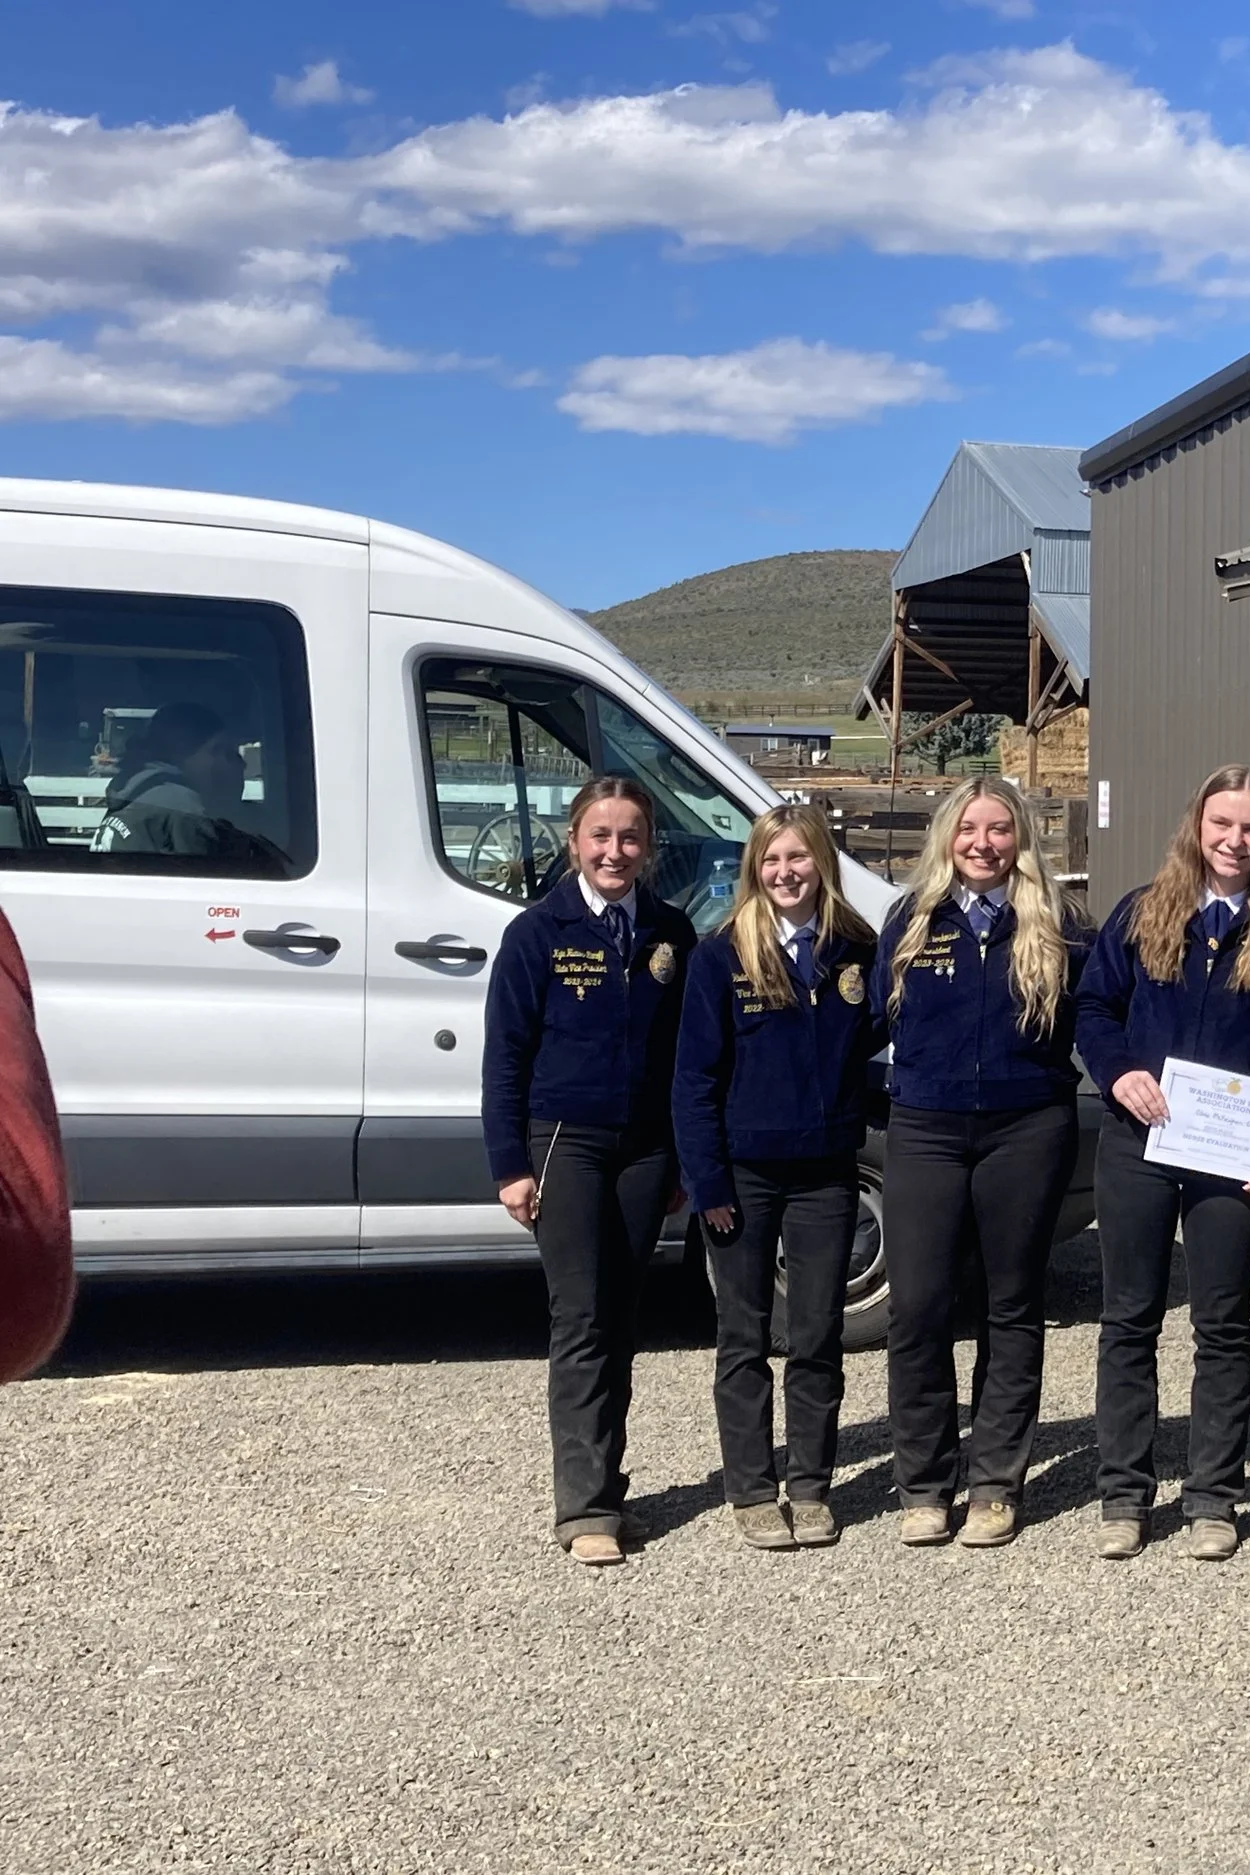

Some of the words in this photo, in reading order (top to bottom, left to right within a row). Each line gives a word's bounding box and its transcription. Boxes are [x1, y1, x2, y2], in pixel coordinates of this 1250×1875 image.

[208, 907, 240, 918] OPEN
[1188, 1086, 1246, 1106] WASHINGTON
[1206, 1138, 1250, 1152] EVALUATION
